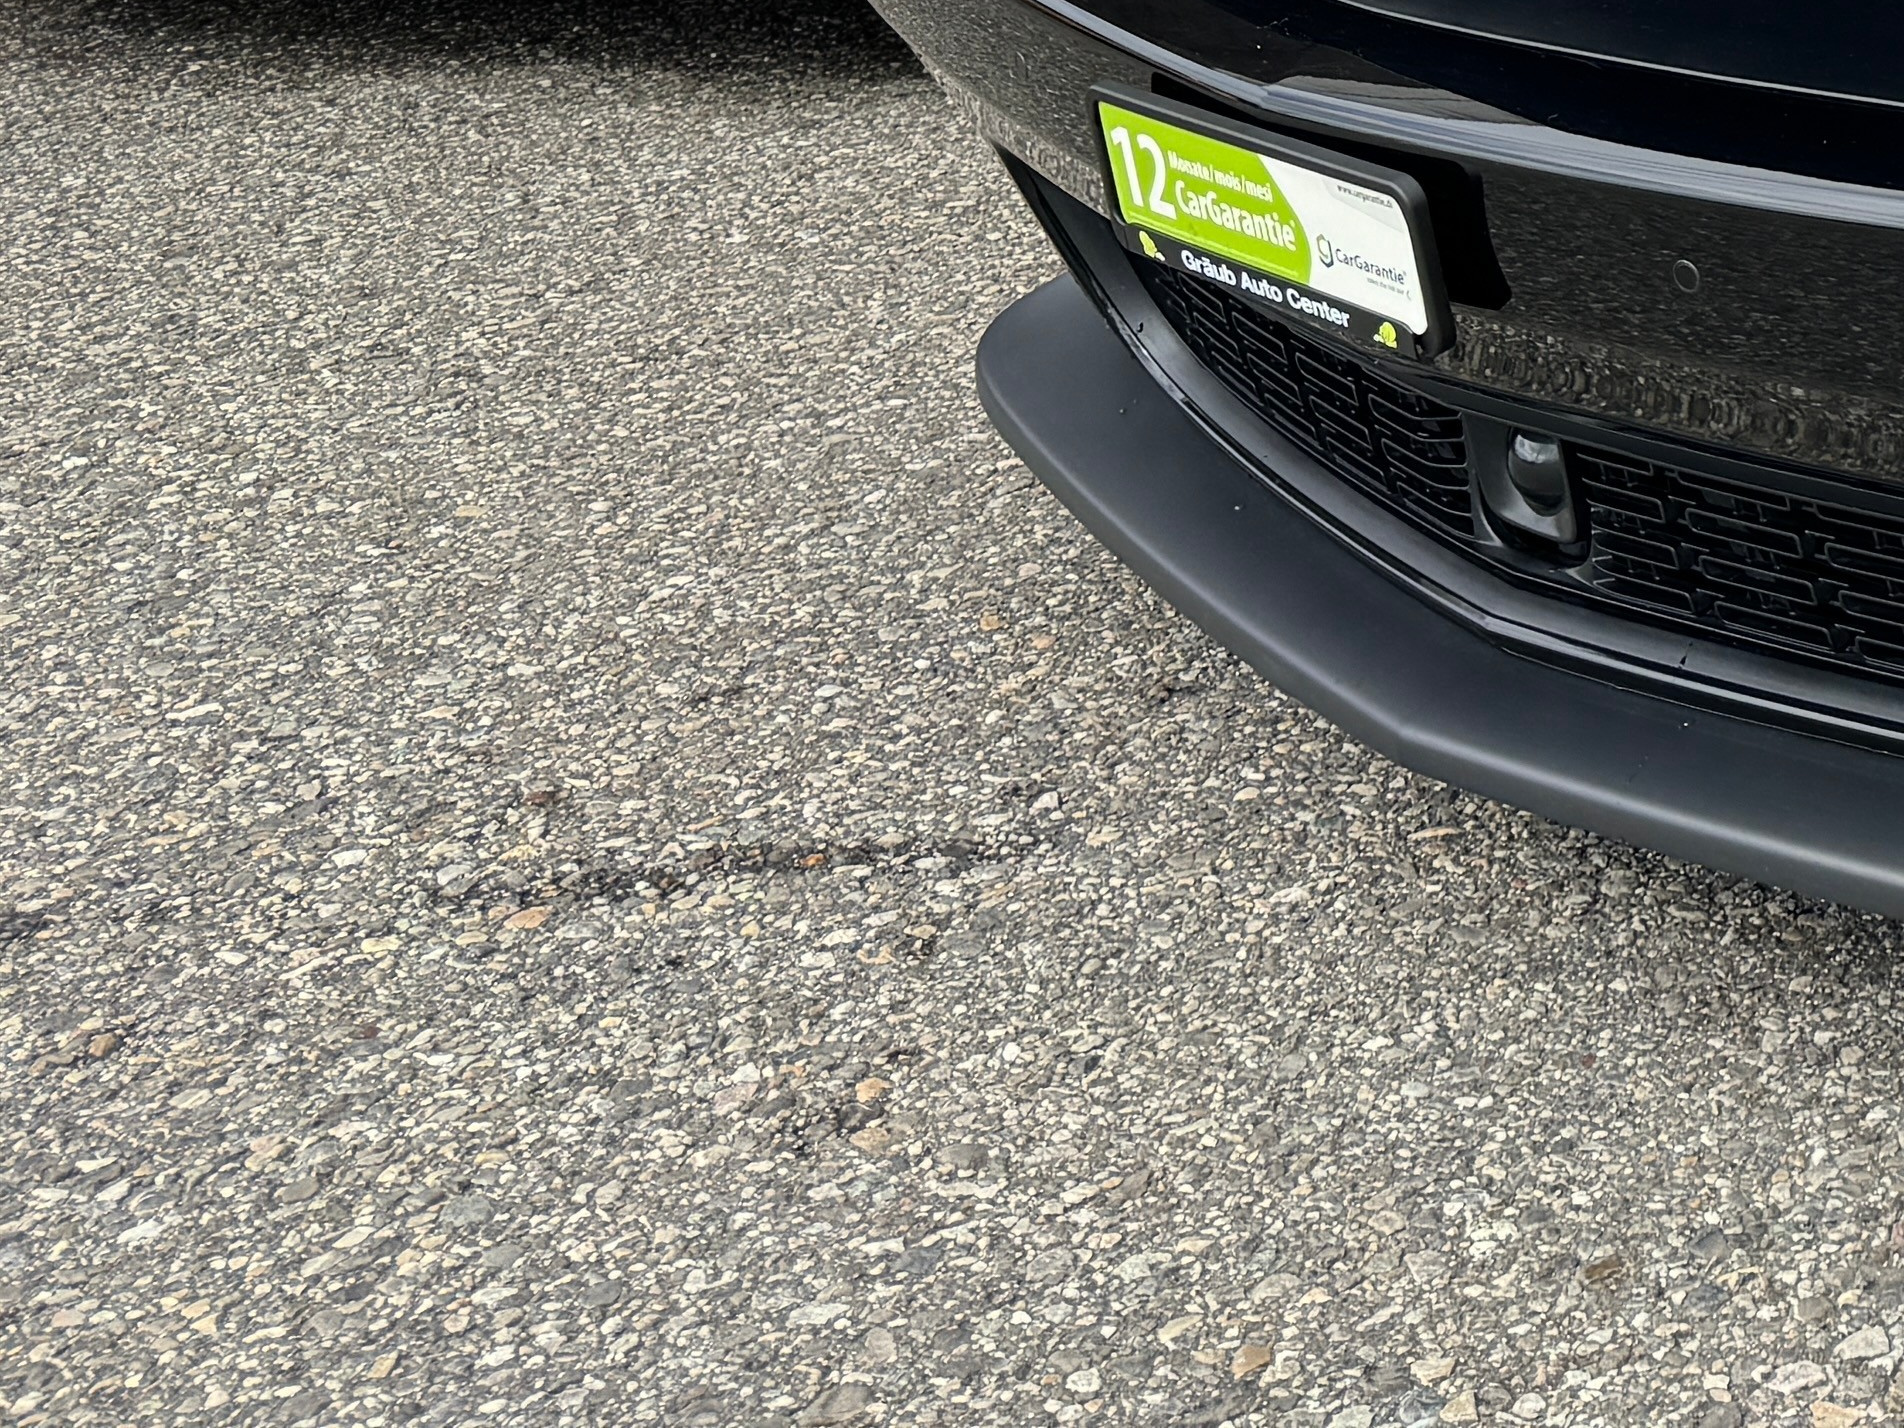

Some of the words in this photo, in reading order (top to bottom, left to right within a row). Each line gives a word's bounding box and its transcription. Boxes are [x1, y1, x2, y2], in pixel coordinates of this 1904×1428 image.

[1110, 126, 1177, 220] 12
[1181, 249, 1238, 286] Gräub
[1240, 273, 1284, 302] Auto
[1286, 288, 1350, 328] Center
